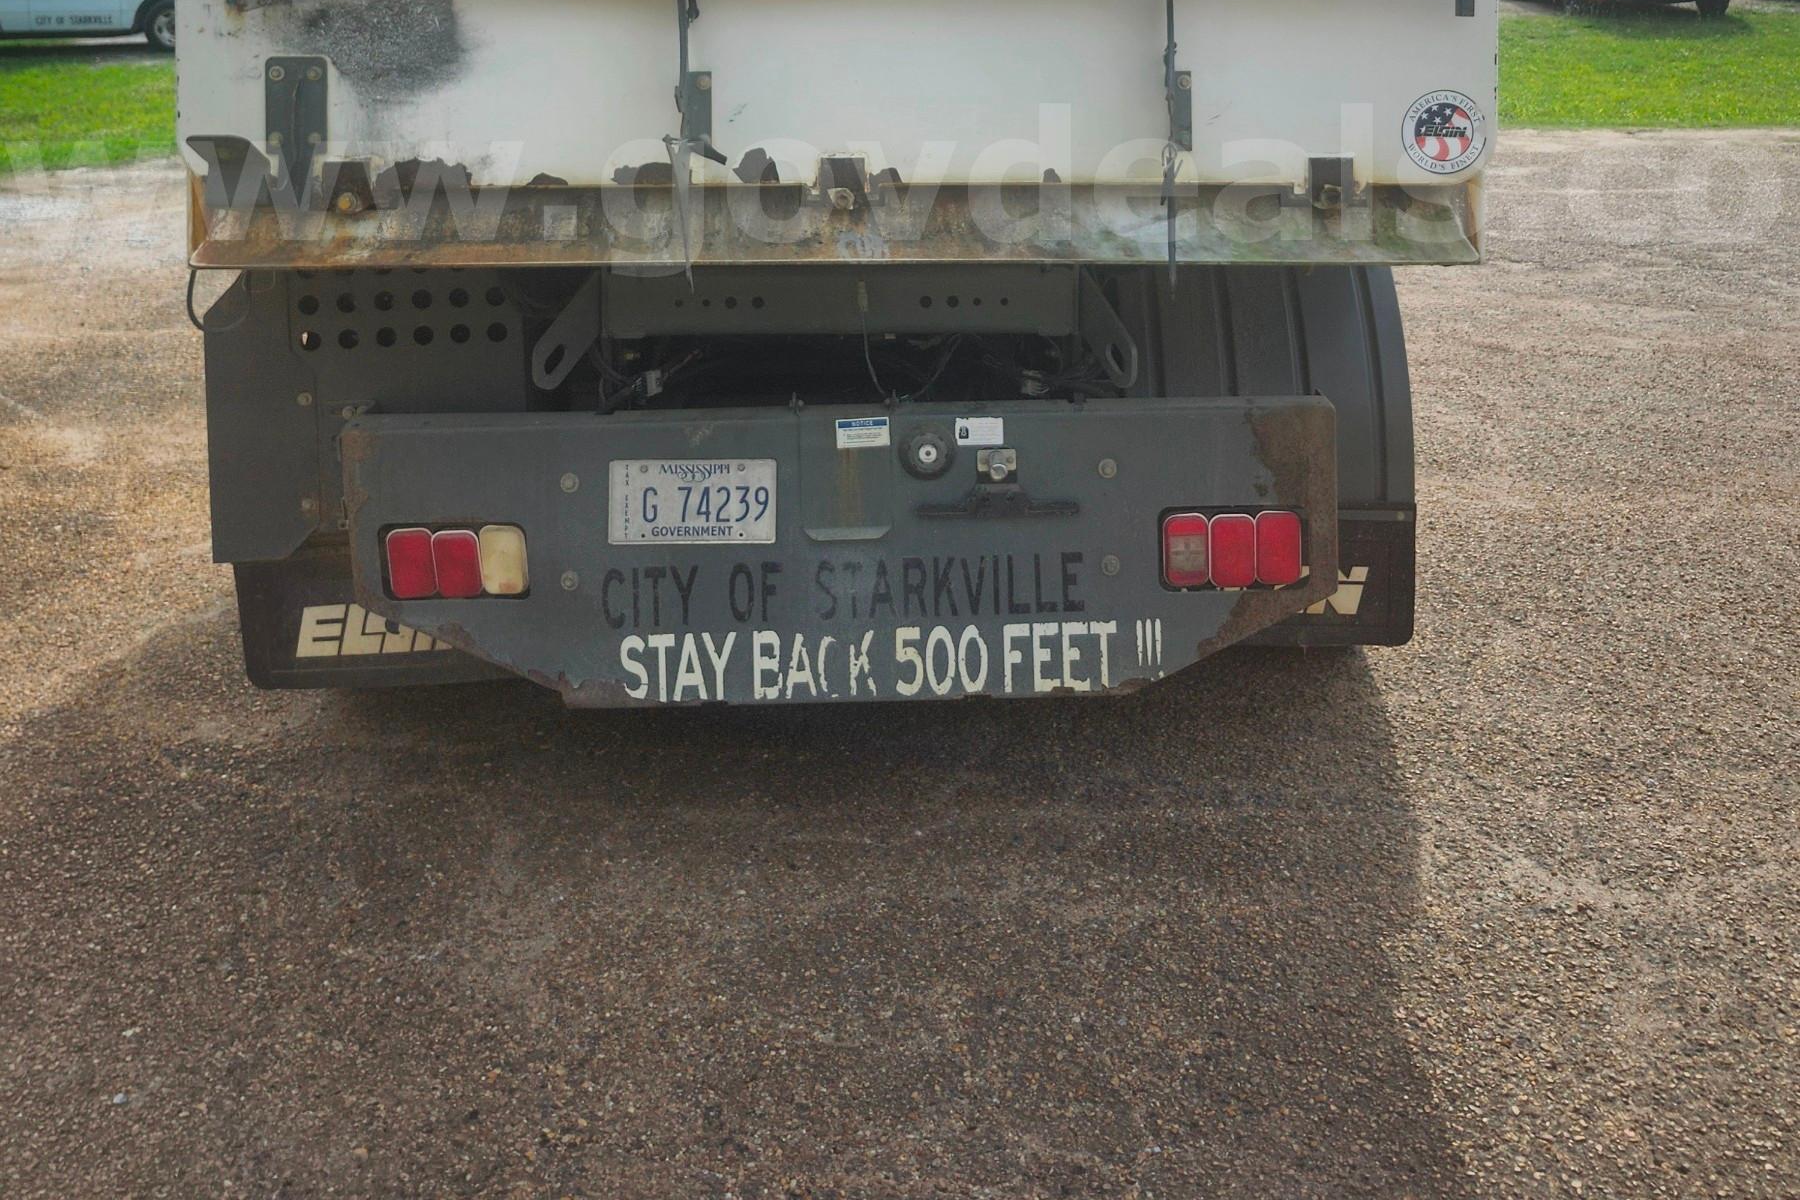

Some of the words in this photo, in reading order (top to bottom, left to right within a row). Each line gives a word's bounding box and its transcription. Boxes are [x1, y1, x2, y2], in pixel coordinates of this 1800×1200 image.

[1409, 94, 1457, 122] AMERICA'S
[1461, 98, 1481, 122] FIRST
[1421, 125, 1467, 138] ELGIN
[1408, 143, 1446, 171] WORLD'S
[1450, 145, 1479, 170] FINEST
[851, 419, 875, 427] NOTICE
[659, 463, 731, 482] MISSISSIPPI
[642, 486, 658, 523] G
[677, 486, 770, 523] 74239
[651, 525, 734, 537] GOVERNMENT
[602, 565, 699, 629] CITY
[729, 560, 784, 623] OF
[814, 551, 1086, 620] STARKVILLE
[620, 632, 737, 703] STAY
[752, 630, 877, 700] BACK
[895, 624, 988, 697] 500
[1002, 619, 1117, 693] FEET
